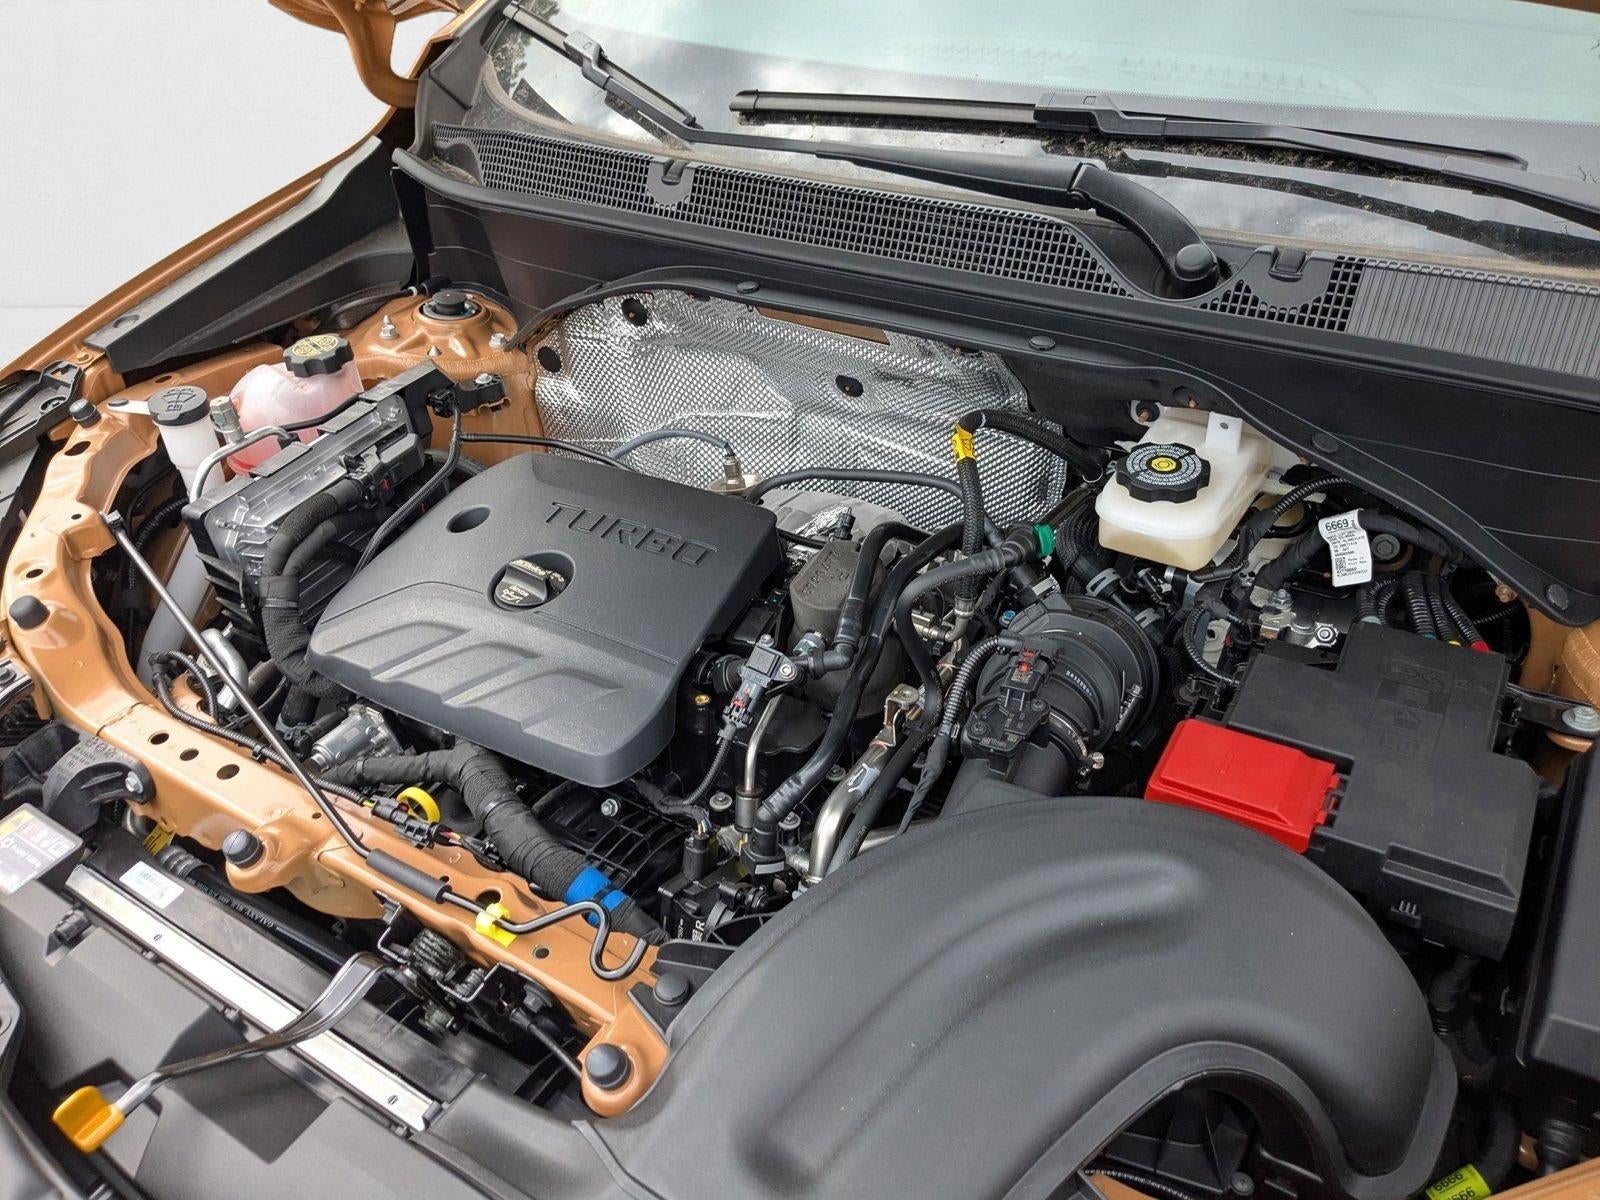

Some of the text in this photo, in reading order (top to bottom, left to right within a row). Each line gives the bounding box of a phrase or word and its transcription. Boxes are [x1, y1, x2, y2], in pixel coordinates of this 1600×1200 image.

[545, 501, 718, 566] TURBO
[1325, 518, 1349, 531] 6669
[244, 910, 274, 928] GALAXY
